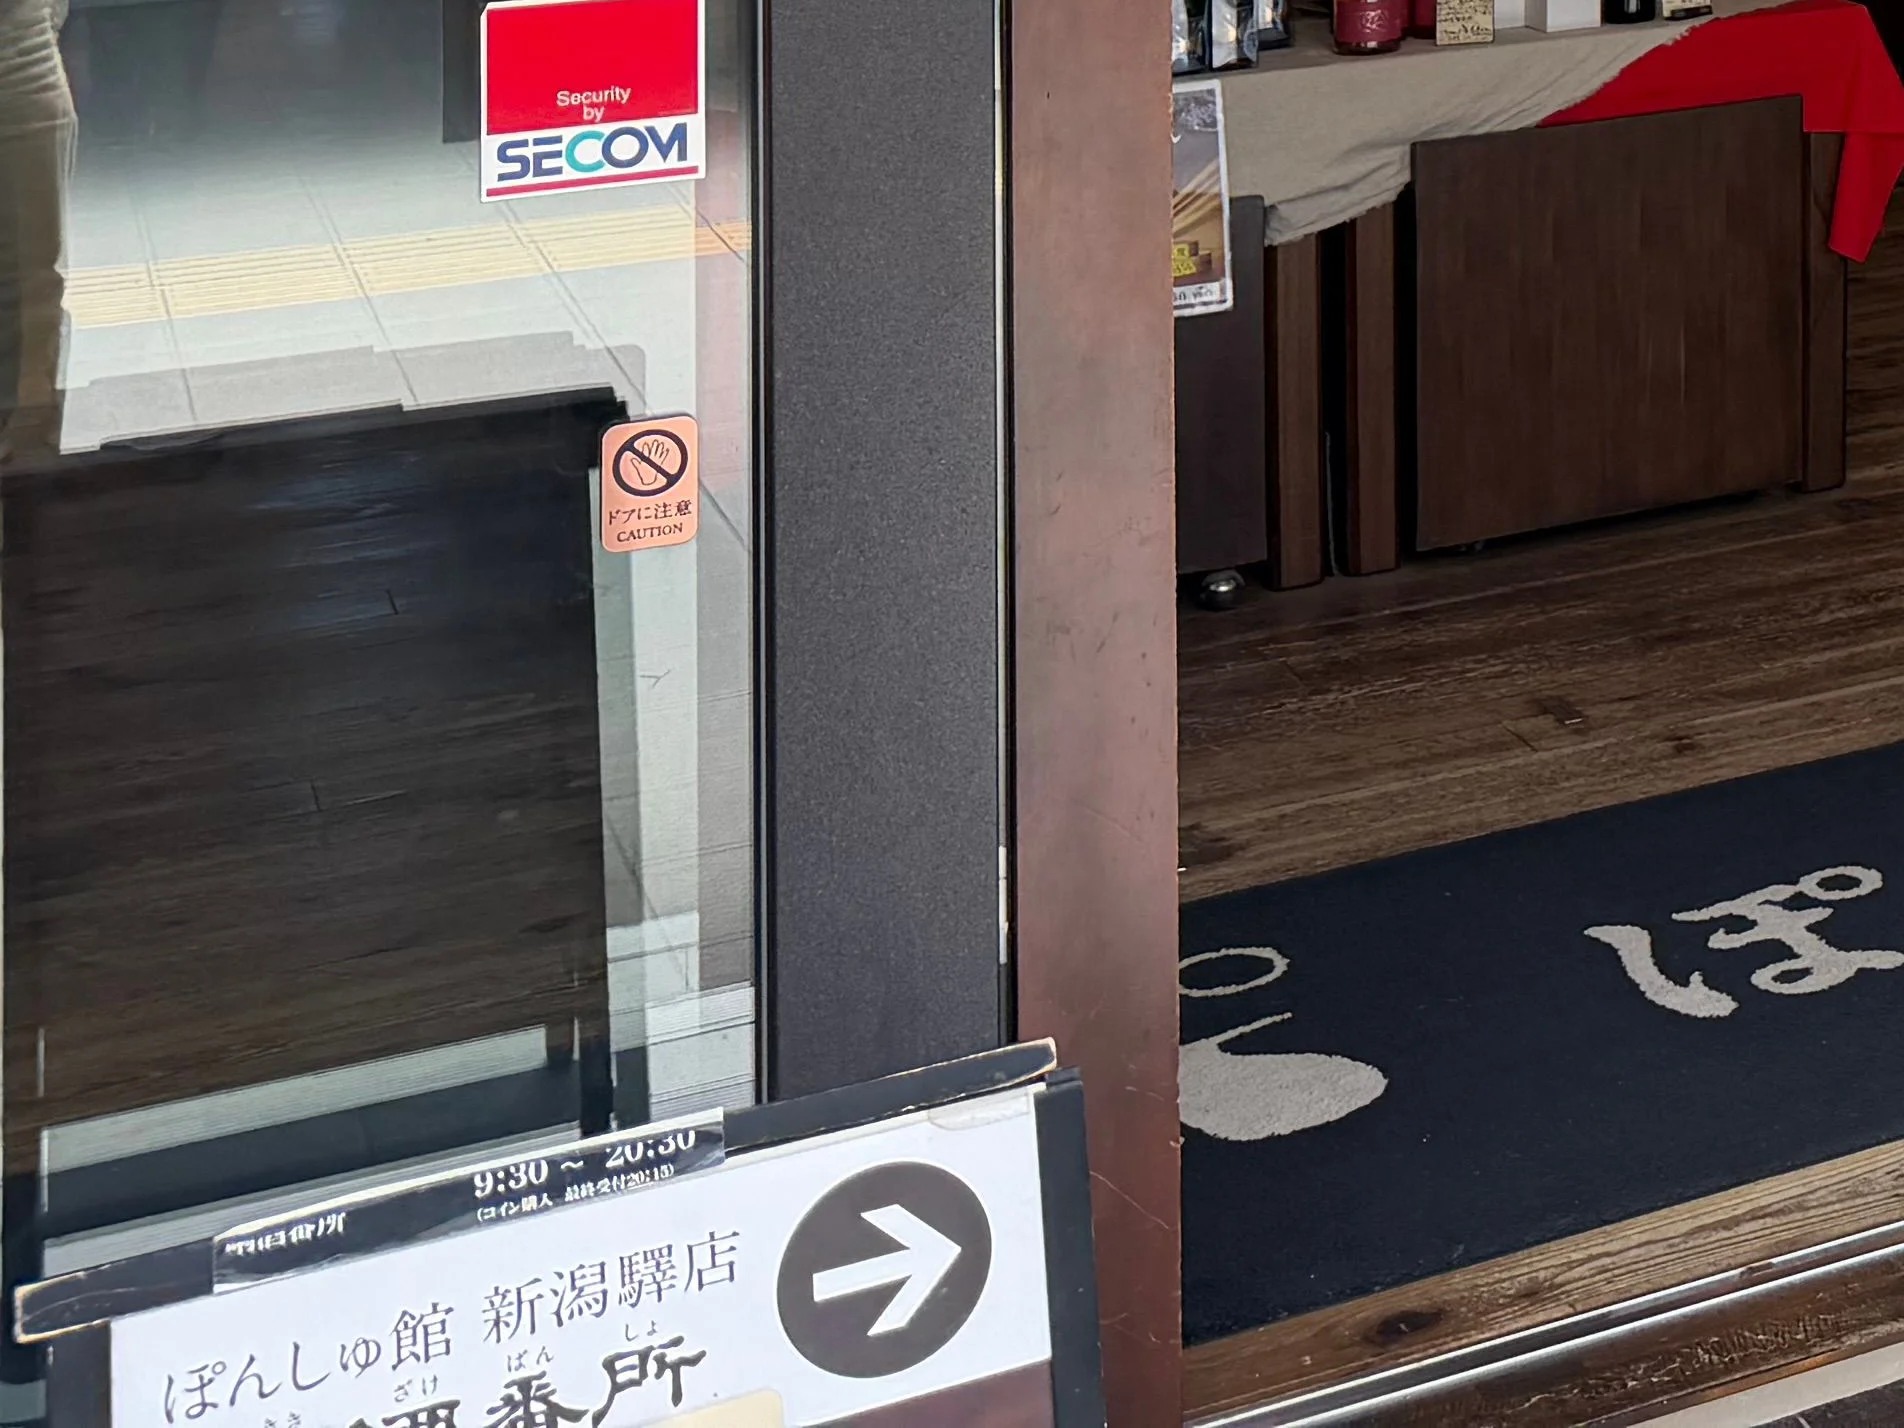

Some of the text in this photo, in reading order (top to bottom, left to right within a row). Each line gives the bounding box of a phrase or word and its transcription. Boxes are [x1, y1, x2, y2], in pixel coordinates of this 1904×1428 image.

[556, 85, 632, 107] Security
[583, 106, 605, 122] by
[497, 122, 688, 182] SECOM
[608, 499, 693, 526] ドアに注意
[616, 522, 683, 543] CAUTION
[164, 1301, 456, 1425] ぽんしゅ館
